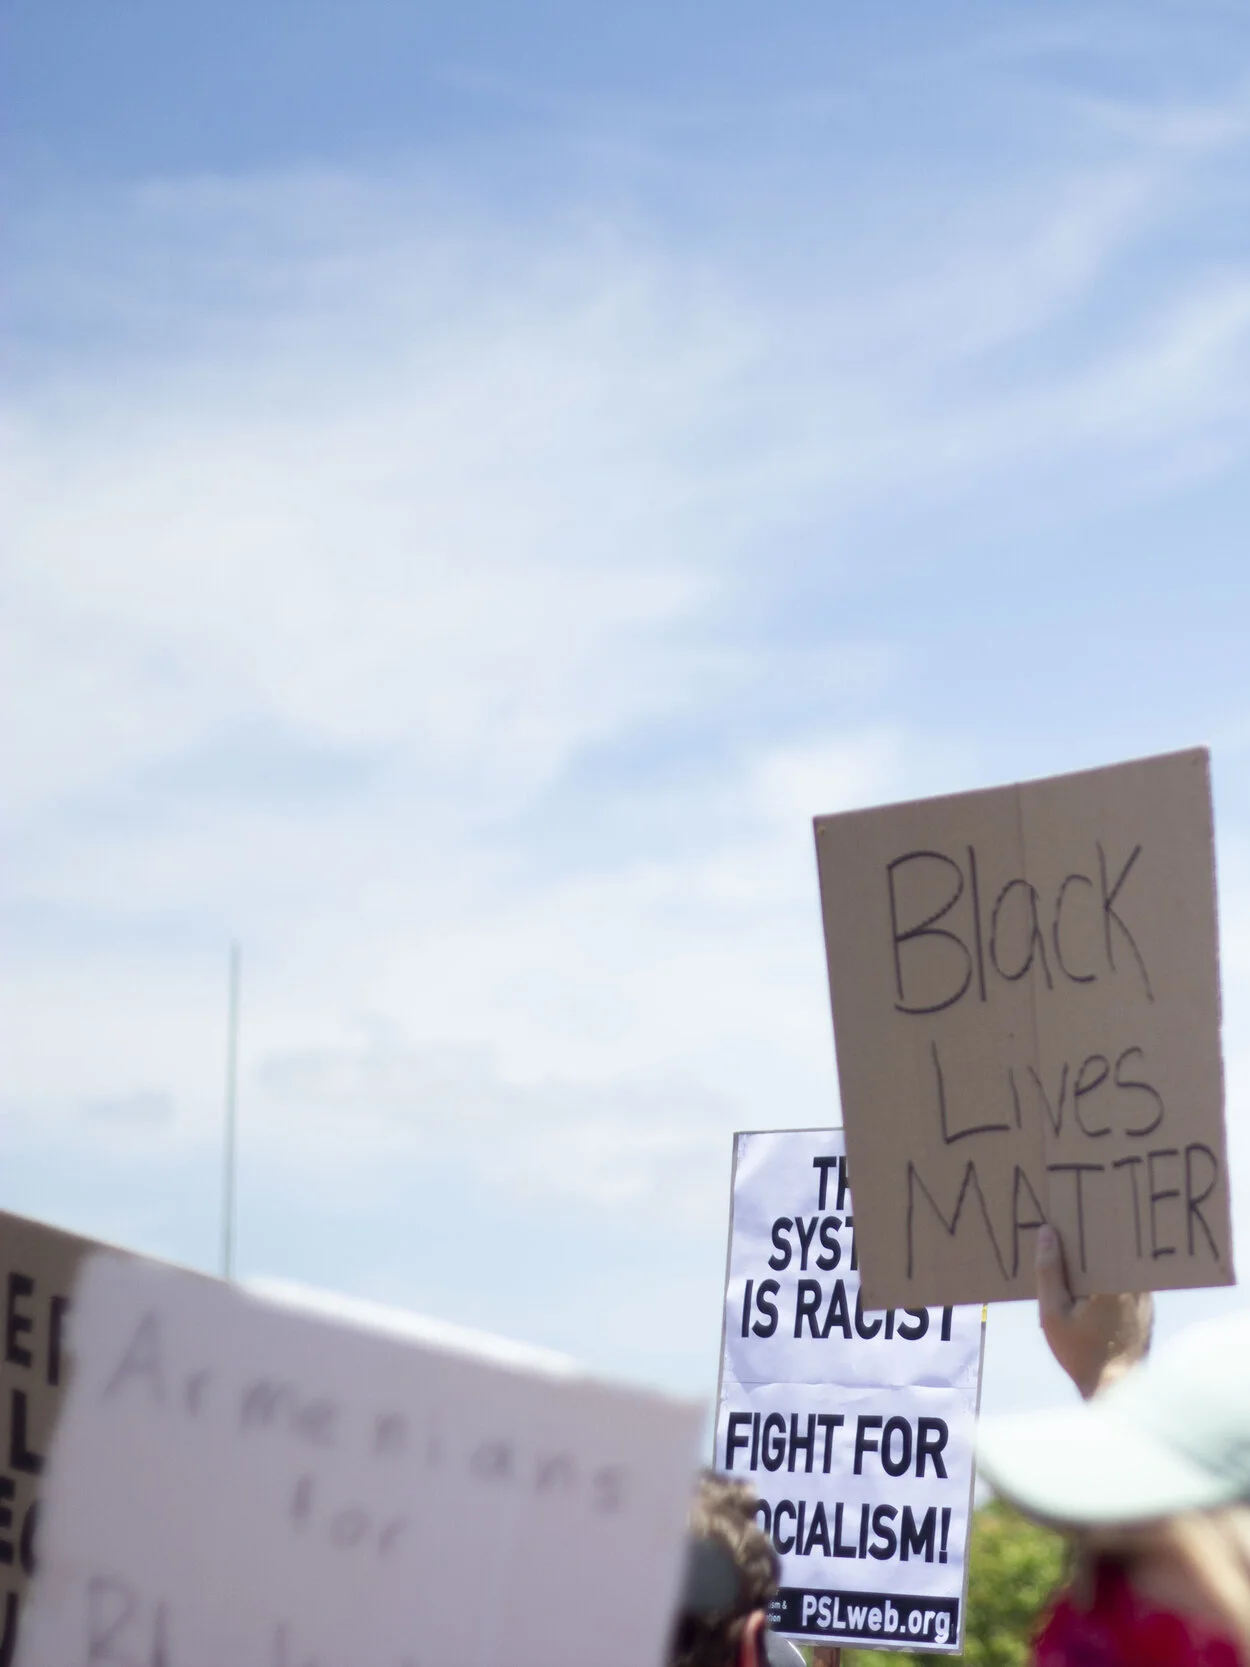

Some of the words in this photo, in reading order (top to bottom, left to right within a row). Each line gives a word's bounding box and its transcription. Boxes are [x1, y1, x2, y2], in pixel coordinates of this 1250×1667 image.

[907, 1143, 1220, 1281] MATTER
[741, 1279, 781, 1339] IS
[725, 1411, 845, 1474] FIGHT
[852, 1414, 949, 1479] FOR
[801, 1594, 951, 1644] PSLweb.org
